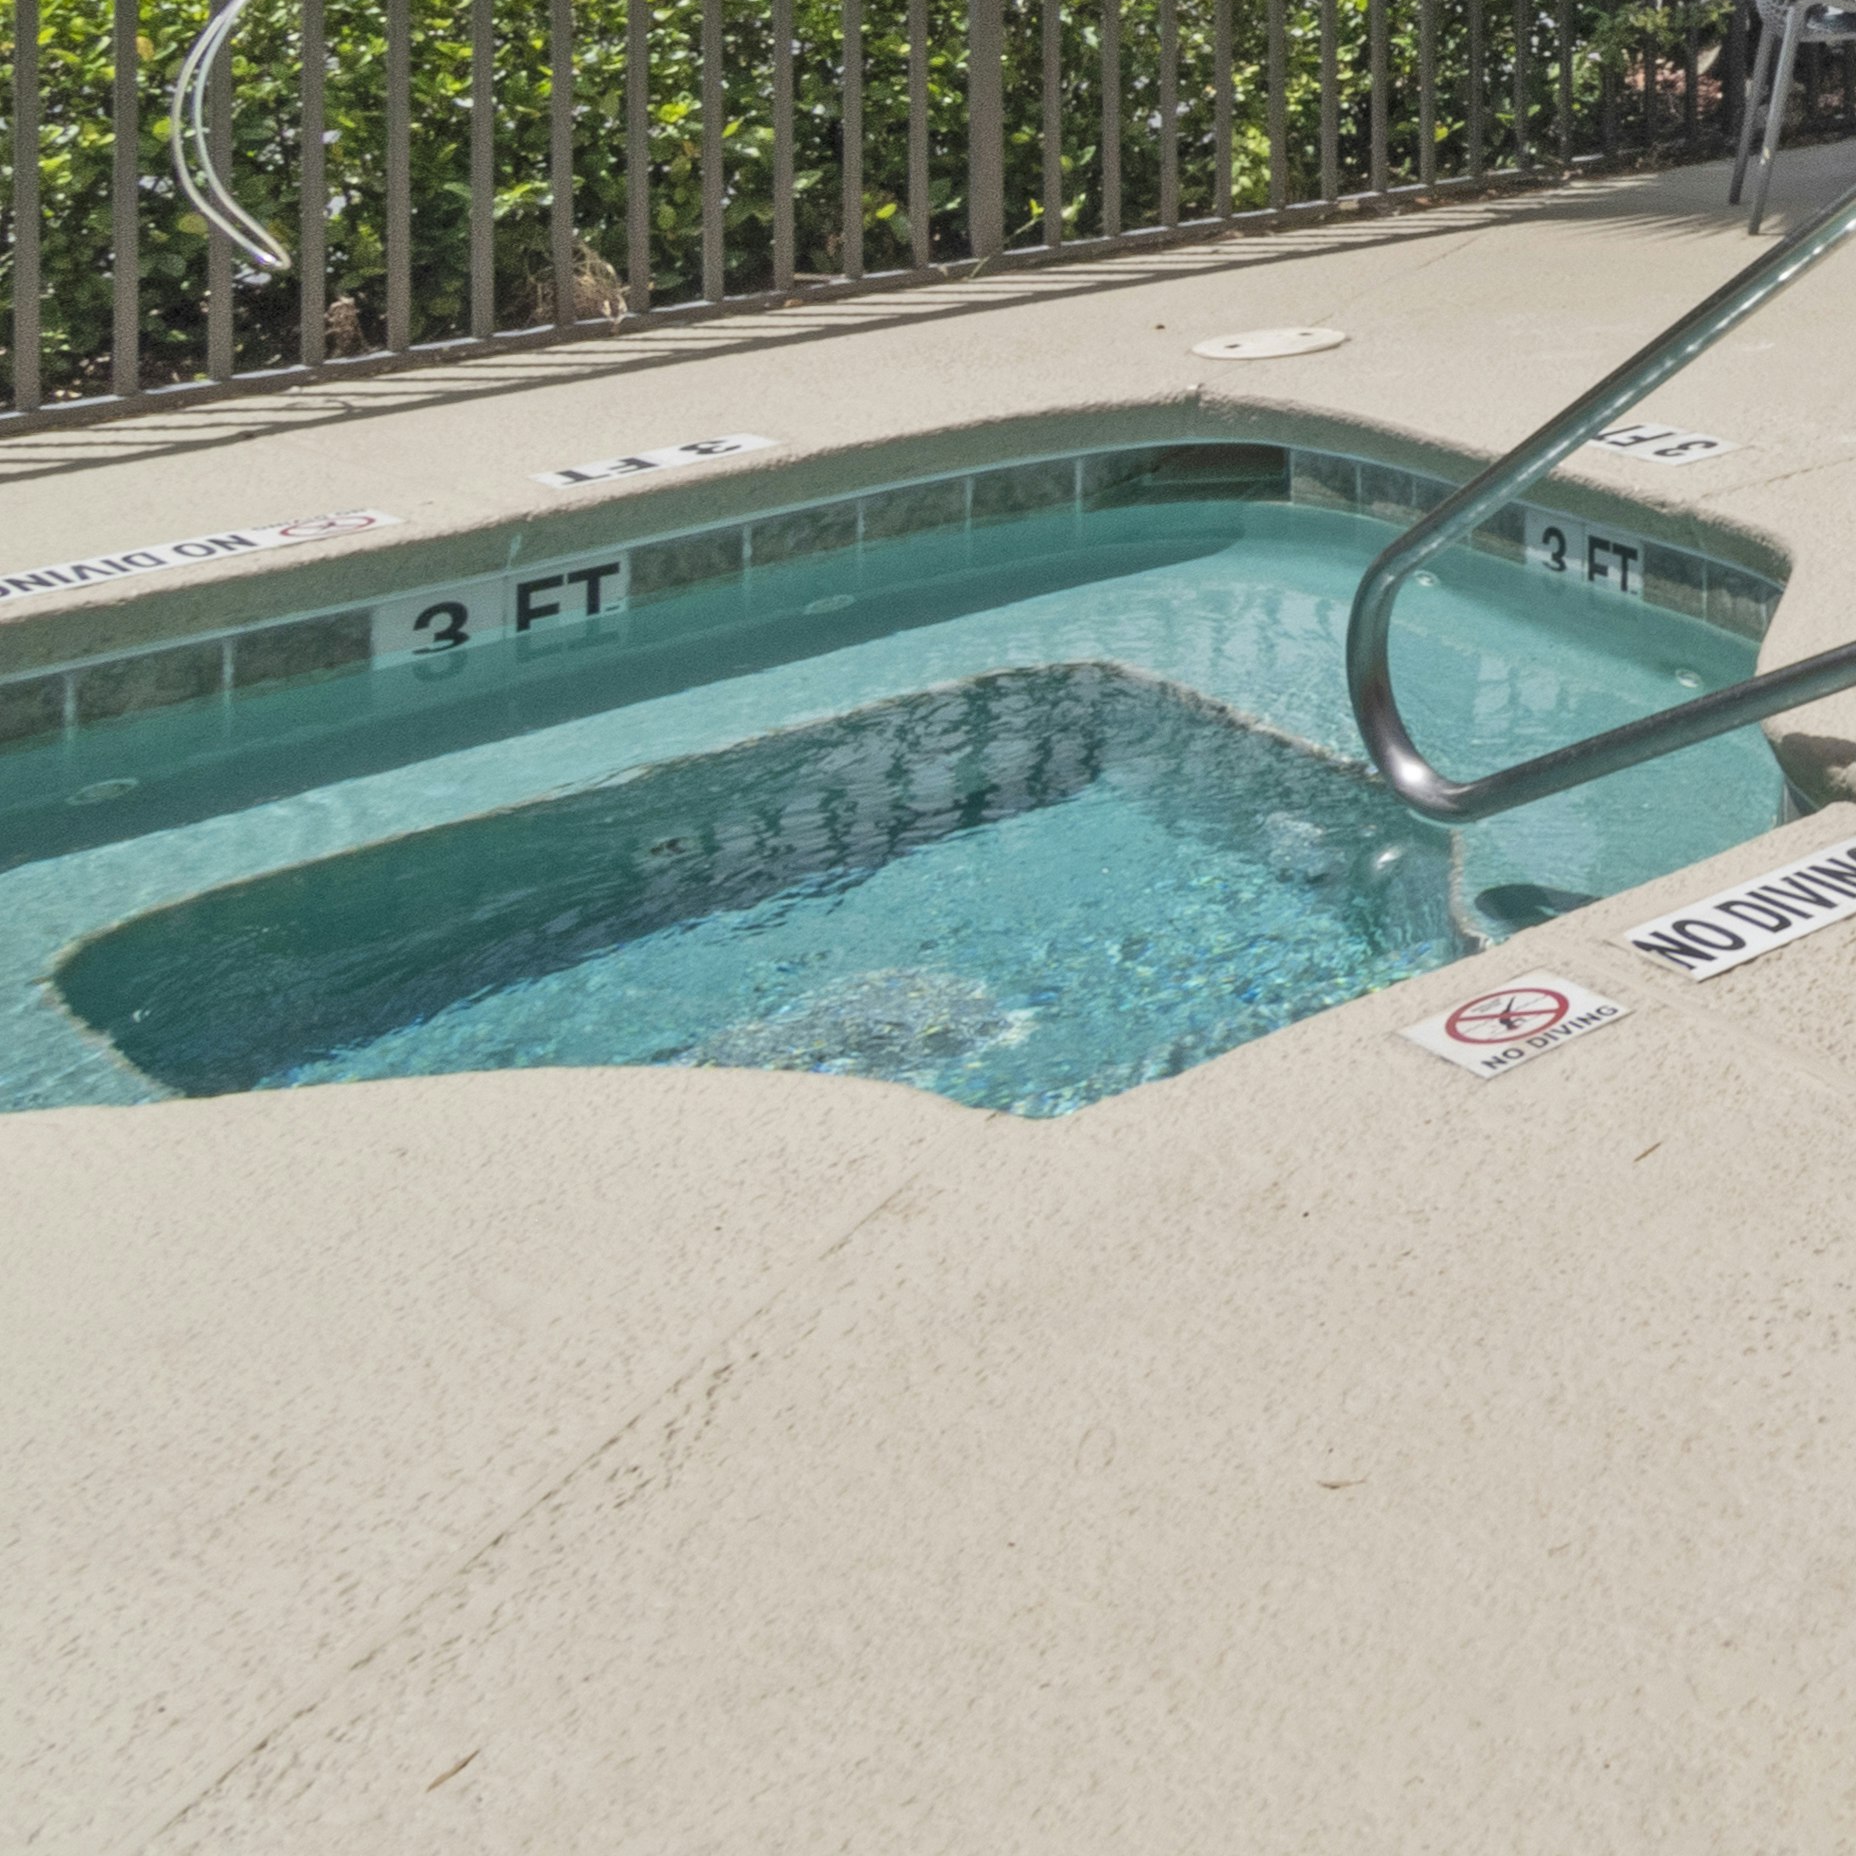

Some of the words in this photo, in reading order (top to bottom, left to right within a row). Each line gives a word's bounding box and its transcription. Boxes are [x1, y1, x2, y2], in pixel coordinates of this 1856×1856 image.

[680, 439, 741, 455] 3
[1653, 440, 1718, 457] 3
[555, 457, 659, 485] FT
[173, 534, 258, 557] NO
[1542, 526, 1566, 572] 3
[0, 552, 168, 597] DIVIN
[413, 600, 470, 656] 3
[1631, 919, 1747, 971] NO
[1481, 1047, 1525, 1070] NO
[1526, 1005, 1619, 1049] DIVING
